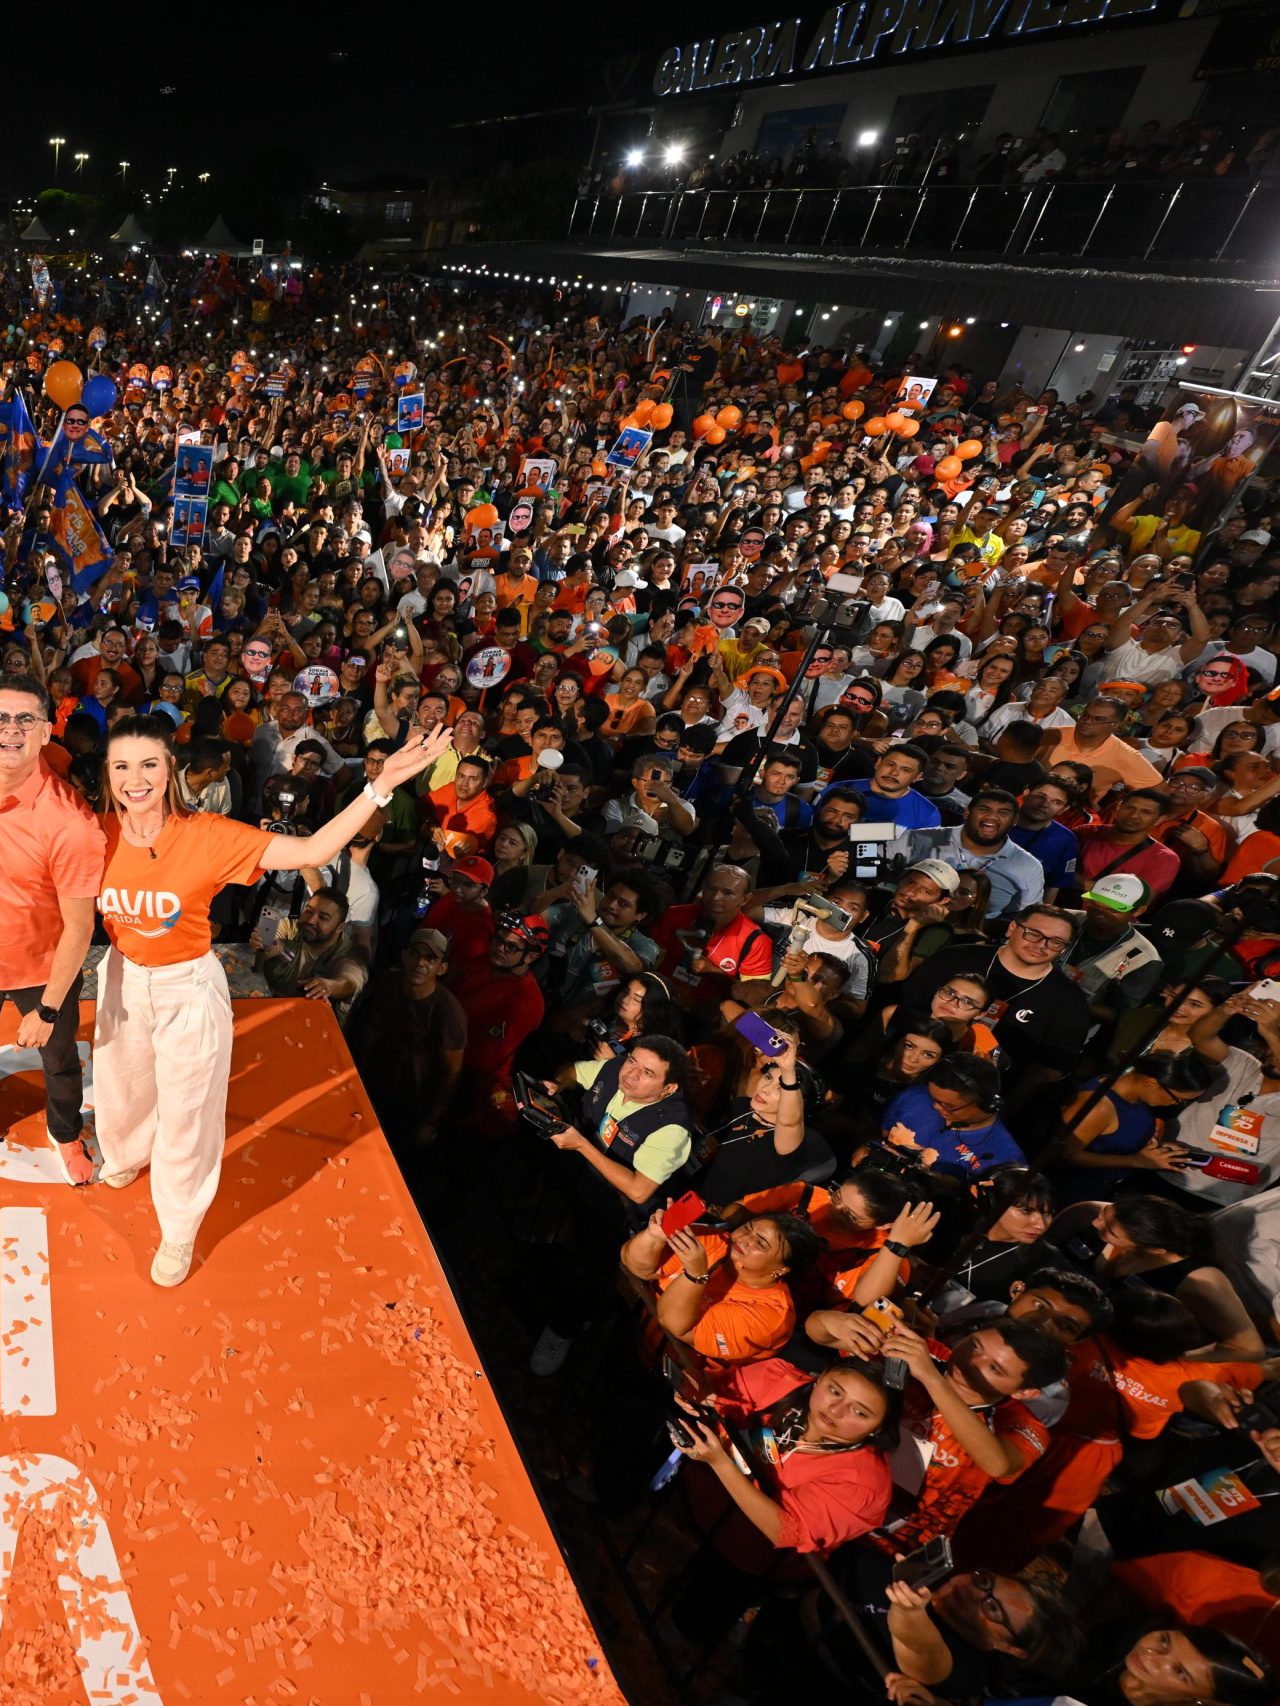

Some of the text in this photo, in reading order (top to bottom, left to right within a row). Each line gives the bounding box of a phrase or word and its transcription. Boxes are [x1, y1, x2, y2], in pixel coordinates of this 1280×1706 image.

[652, 16, 802, 96] GALERIA
[96, 887, 182, 918] AVID
[1215, 1130, 1249, 1146] IMPRENSA
